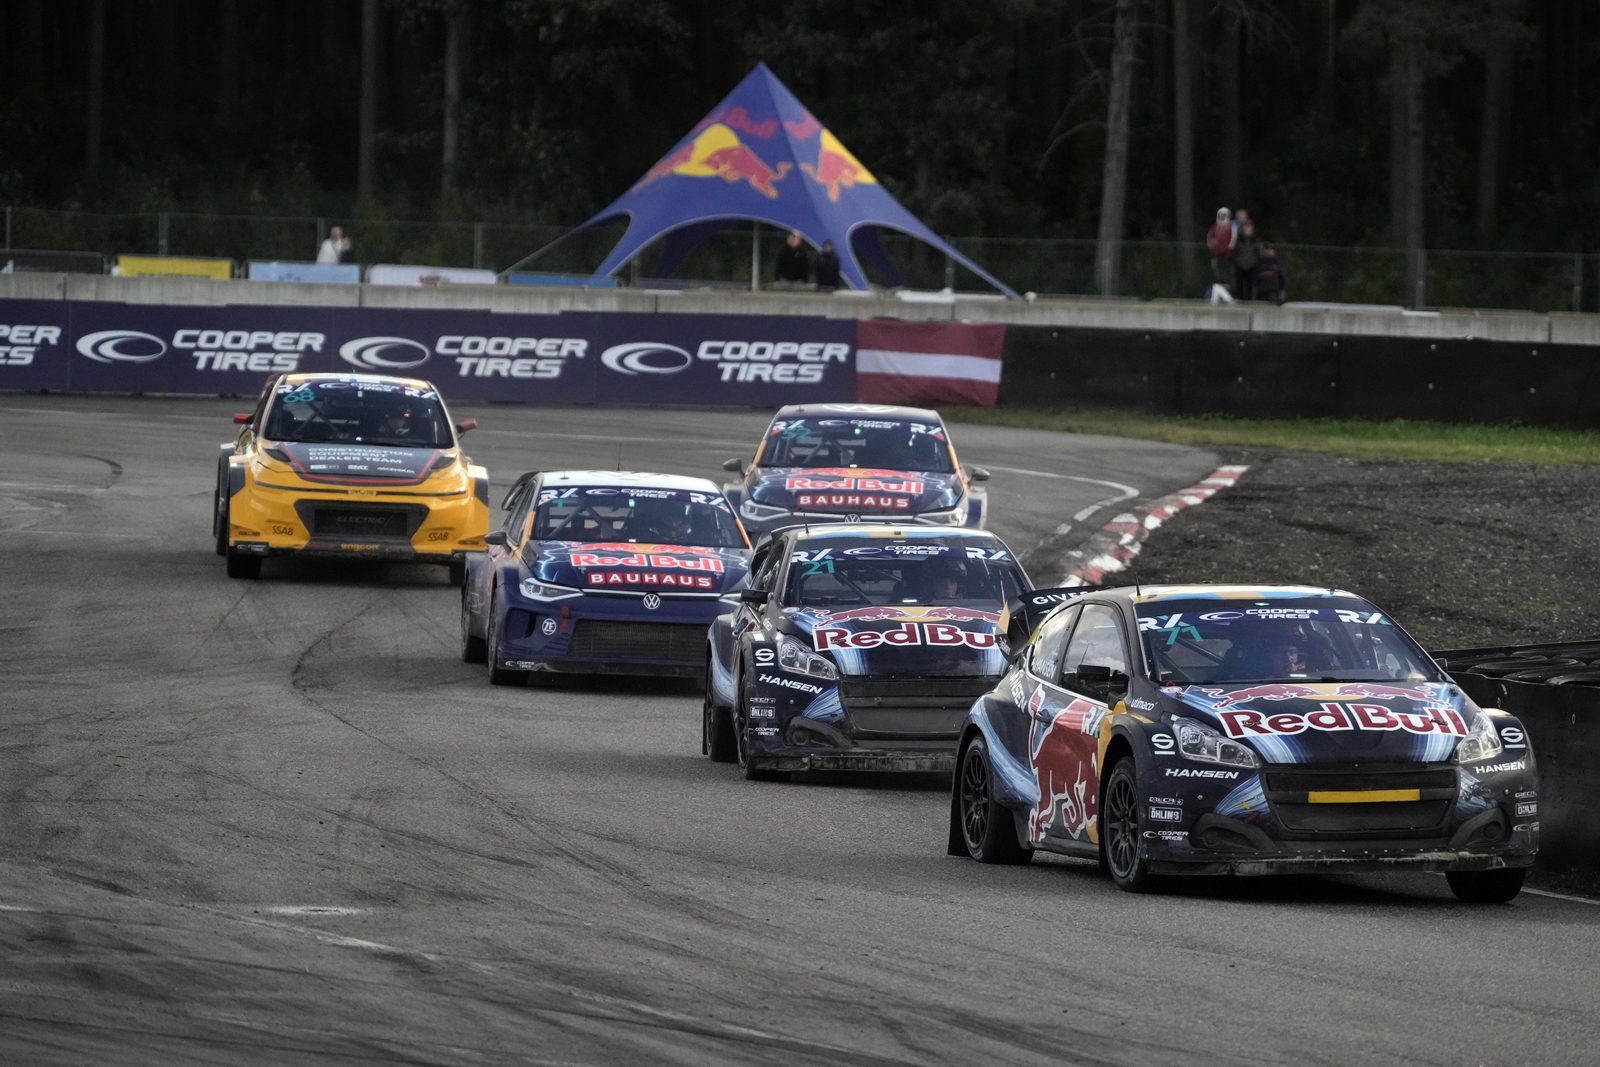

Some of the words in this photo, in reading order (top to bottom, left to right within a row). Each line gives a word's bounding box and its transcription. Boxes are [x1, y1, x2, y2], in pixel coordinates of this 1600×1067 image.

[171, 329, 326, 351] COOPER
[435, 335, 589, 358] COOPER
[697, 341, 850, 362] COOPER
[192, 350, 303, 371] TIRES
[455, 356, 566, 378] TIRES
[717, 362, 827, 383] TIRES
[282, 389, 315, 404] 68
[308, 448, 413, 457] CONSTRUCTION
[620, 488, 677, 496] COOPER
[785, 478, 856, 490] Red
[857, 478, 924, 494] Bull
[800, 495, 910, 508] BAUHAUS
[272, 525, 294, 536] SSAB
[427, 531, 449, 542] SSAB
[570, 554, 648, 567] Red
[651, 555, 724, 573] Bull
[801, 560, 836, 575] 21
[591, 573, 712, 587] BAUHAUS
[813, 622, 921, 651] Red
[758, 674, 823, 694] HANSEN
[1131, 697, 1160, 711] utimaco
[1218, 702, 1353, 739] Red
[1352, 705, 1468, 737] Bull
[1165, 768, 1239, 779] HANSEN
[1473, 761, 1526, 774] HANSEN
[1151, 806, 1180, 820] ÖHLINS
